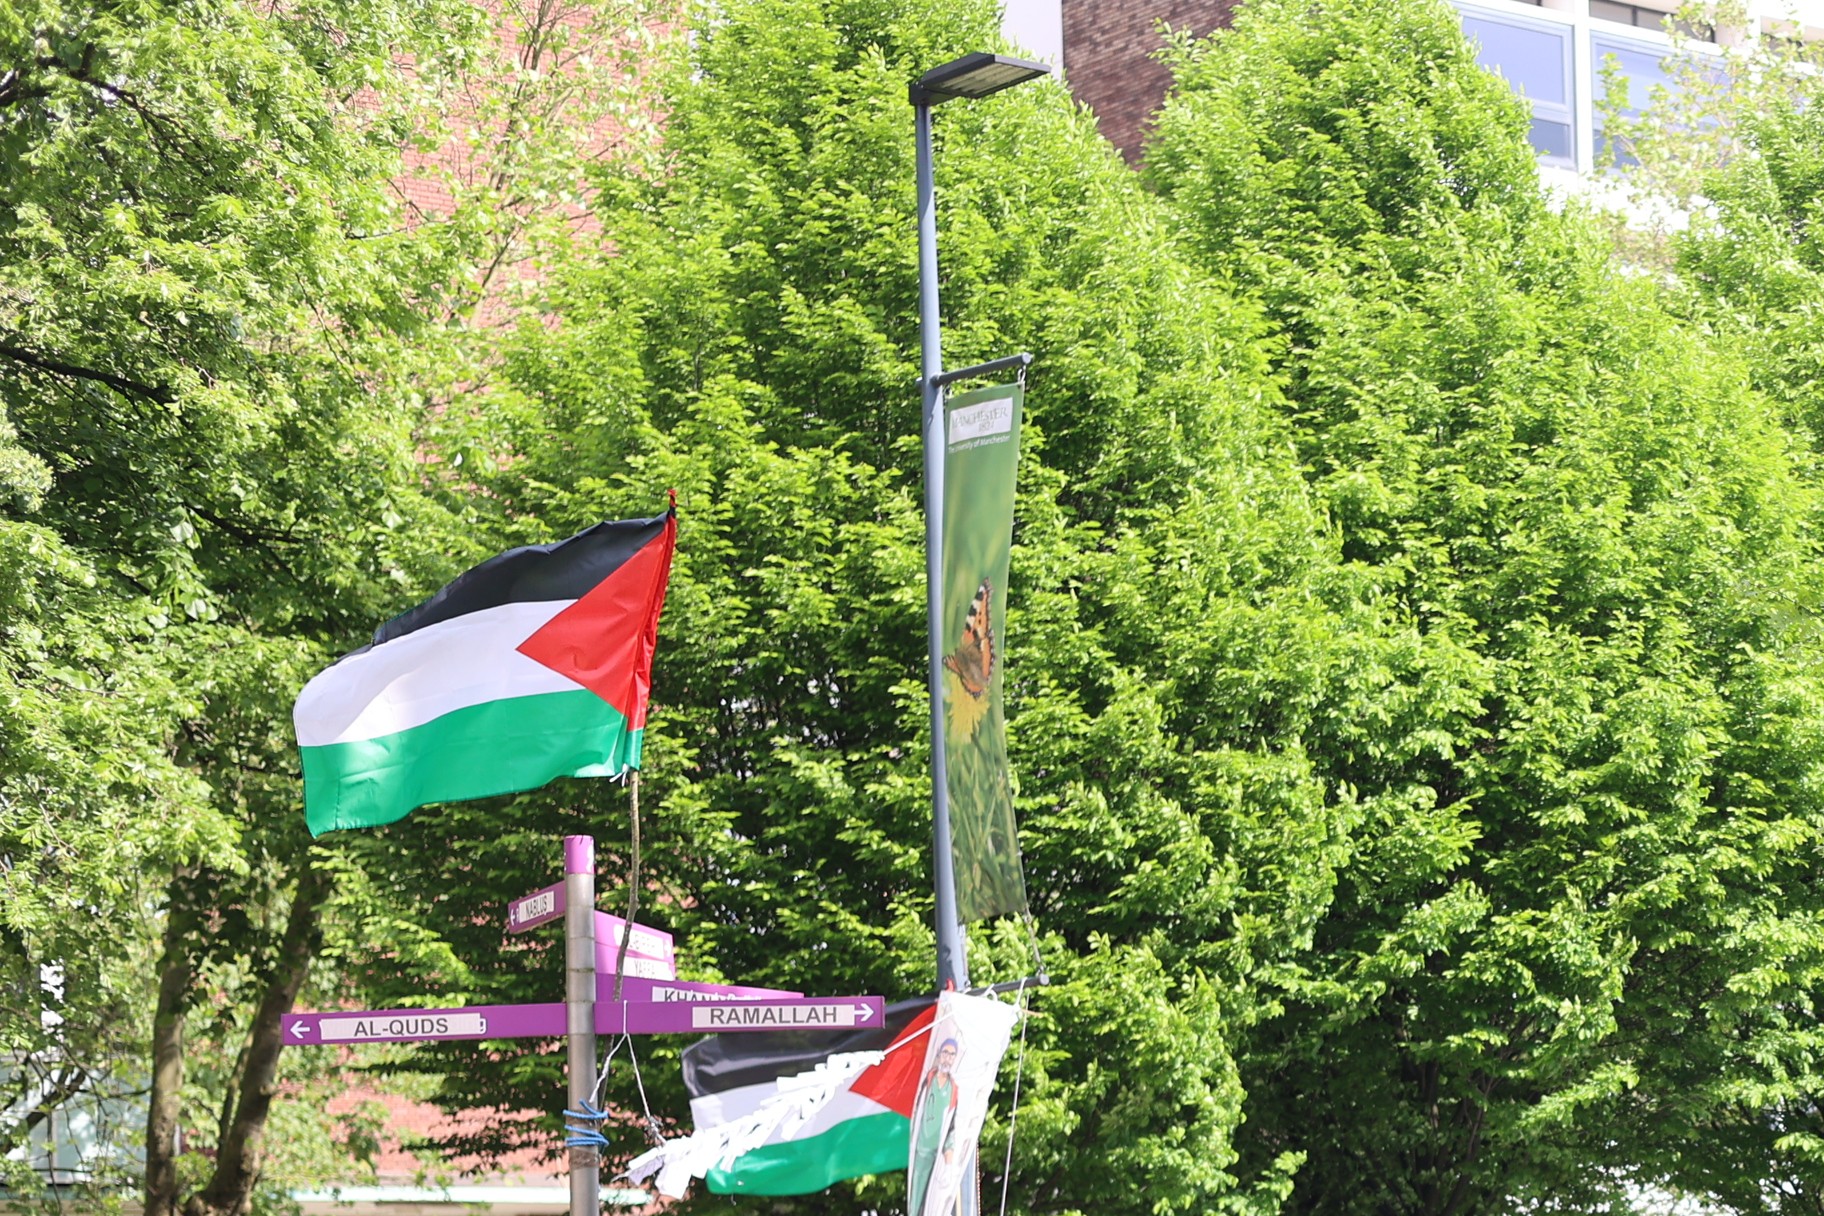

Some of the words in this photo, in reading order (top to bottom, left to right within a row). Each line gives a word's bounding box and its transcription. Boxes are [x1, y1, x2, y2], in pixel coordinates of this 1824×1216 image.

[525, 894, 548, 918] NABLUS
[710, 1006, 837, 1025] RAMALLAH
[353, 1018, 449, 1037] AL-QUDS
